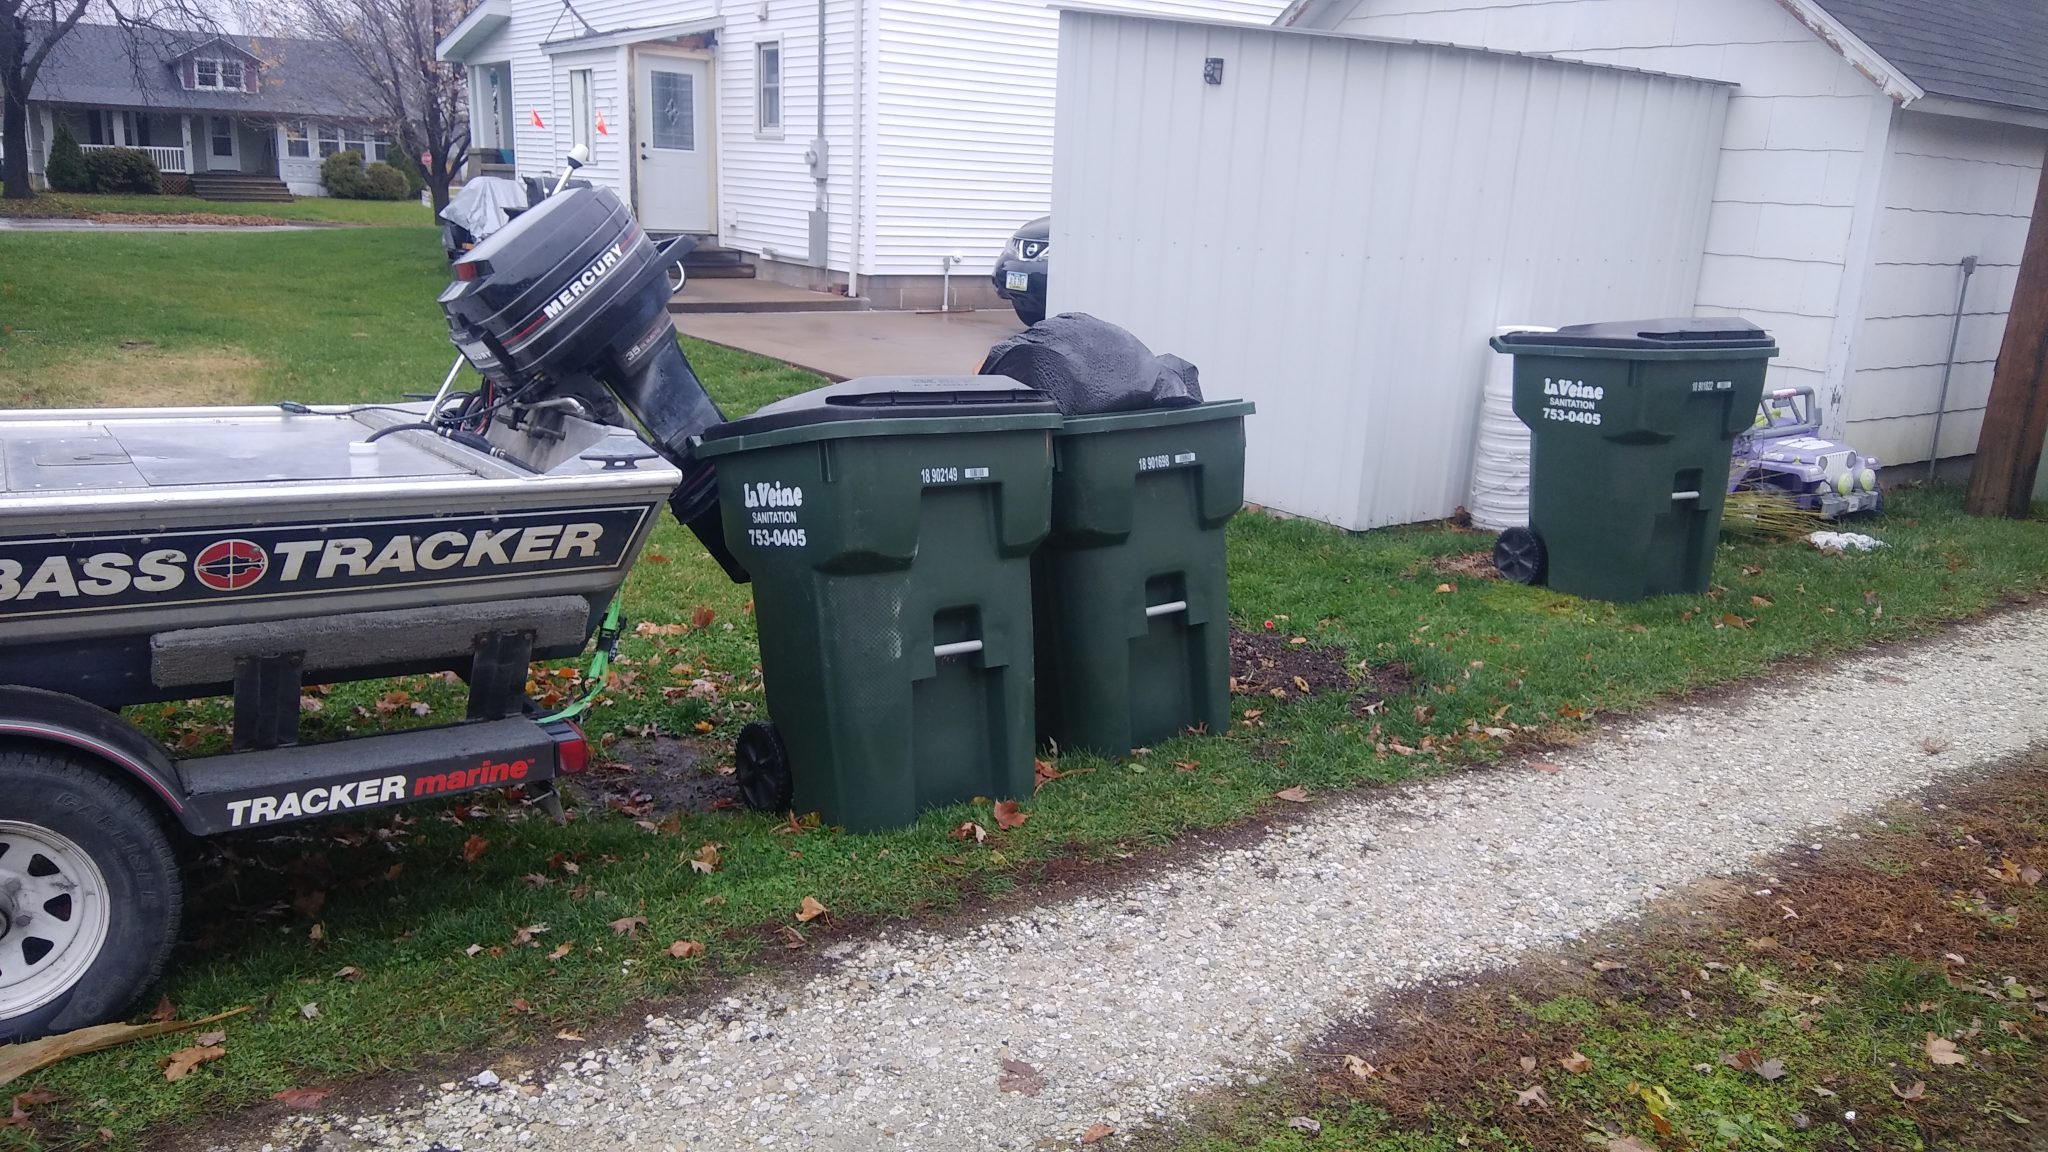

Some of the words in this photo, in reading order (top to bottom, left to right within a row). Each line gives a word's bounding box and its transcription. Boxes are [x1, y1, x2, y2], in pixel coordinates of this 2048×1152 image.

[543, 243, 624, 319] MERCURY
[625, 345, 641, 361] 35
[1549, 397, 1595, 410] SANITATION
[1543, 407, 1602, 425] 753-0405
[1139, 458, 1147, 471] 18
[921, 468, 930, 483] 18
[931, 467, 958, 483] 902149
[752, 511, 797, 524] SANITATION
[748, 528, 807, 547] 753-0405
[273, 522, 604, 582] TRACKER
[226, 775, 407, 827] TRACKER
[414, 759, 529, 796] marine
